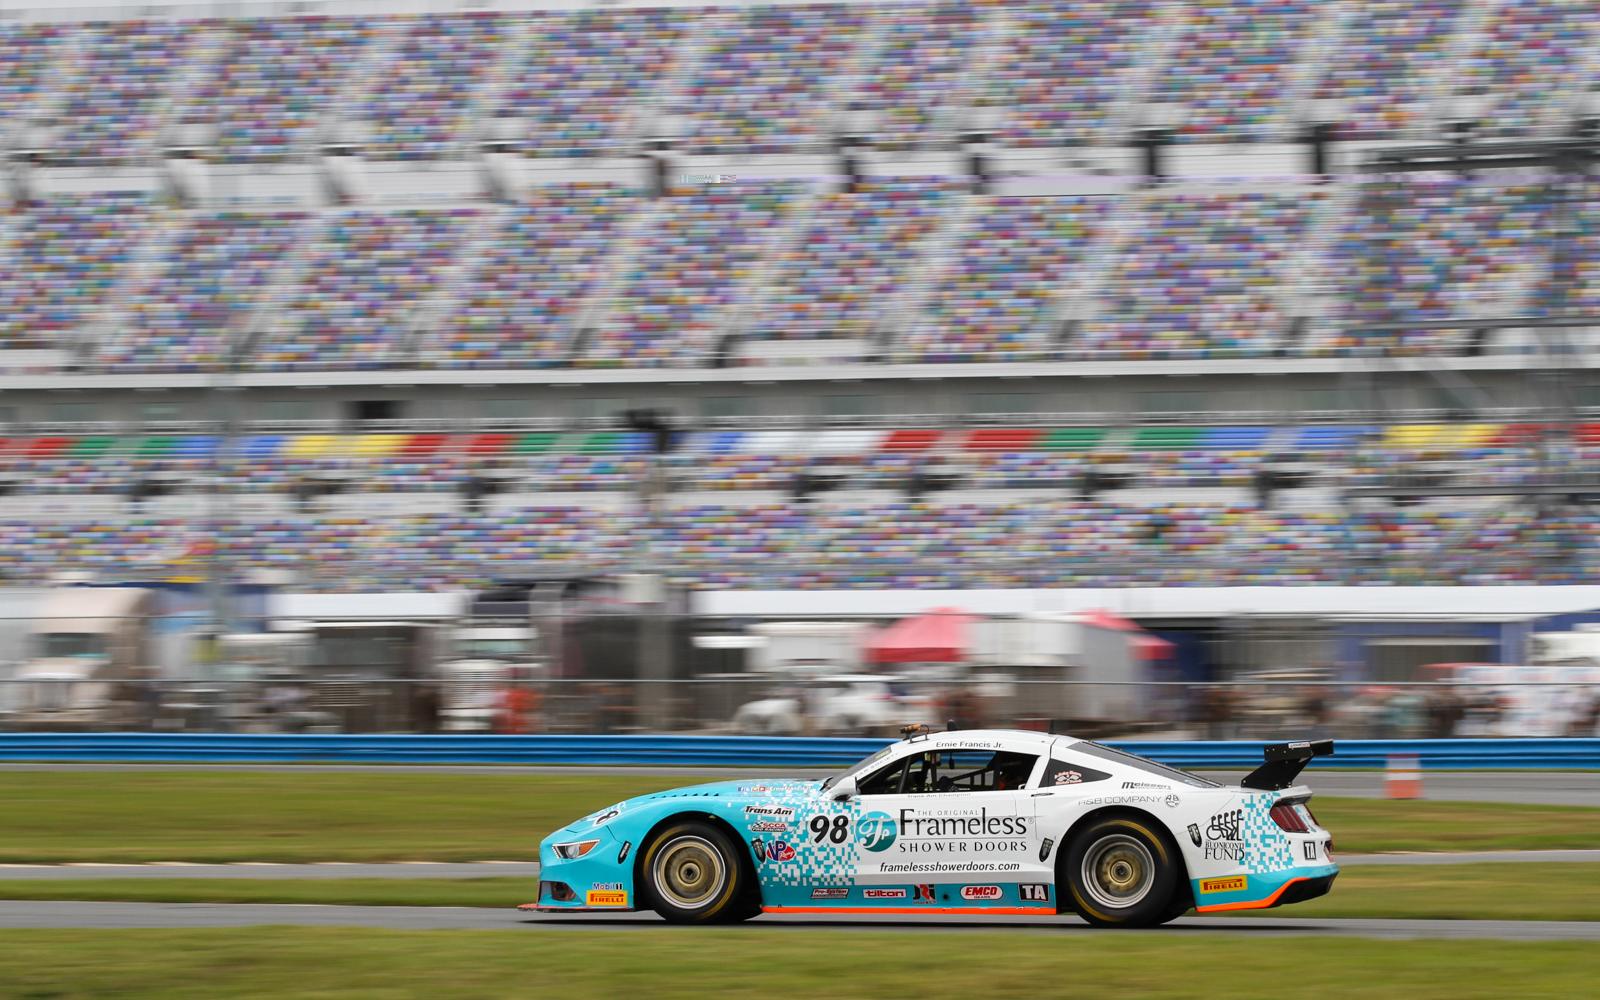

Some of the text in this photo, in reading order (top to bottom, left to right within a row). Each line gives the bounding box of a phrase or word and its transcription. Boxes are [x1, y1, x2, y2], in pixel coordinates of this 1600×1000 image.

[1104, 795, 1162, 804] COMPANY
[744, 805, 793, 815] Trans Am
[900, 807, 1027, 836] Frameless
[810, 814, 849, 844] 98
[767, 840, 787, 861] VP
[900, 841, 1027, 853] SHOWER DOORS
[1304, 842, 1316, 859] TA
[1204, 848, 1245, 861] FUND
[880, 861, 1020, 873] framelessshowerdoors.com
[965, 886, 998, 896] EMCO
[1203, 878, 1243, 891] PIRELLI
[590, 893, 624, 903] PIRELLI
[1022, 885, 1047, 900] TA
